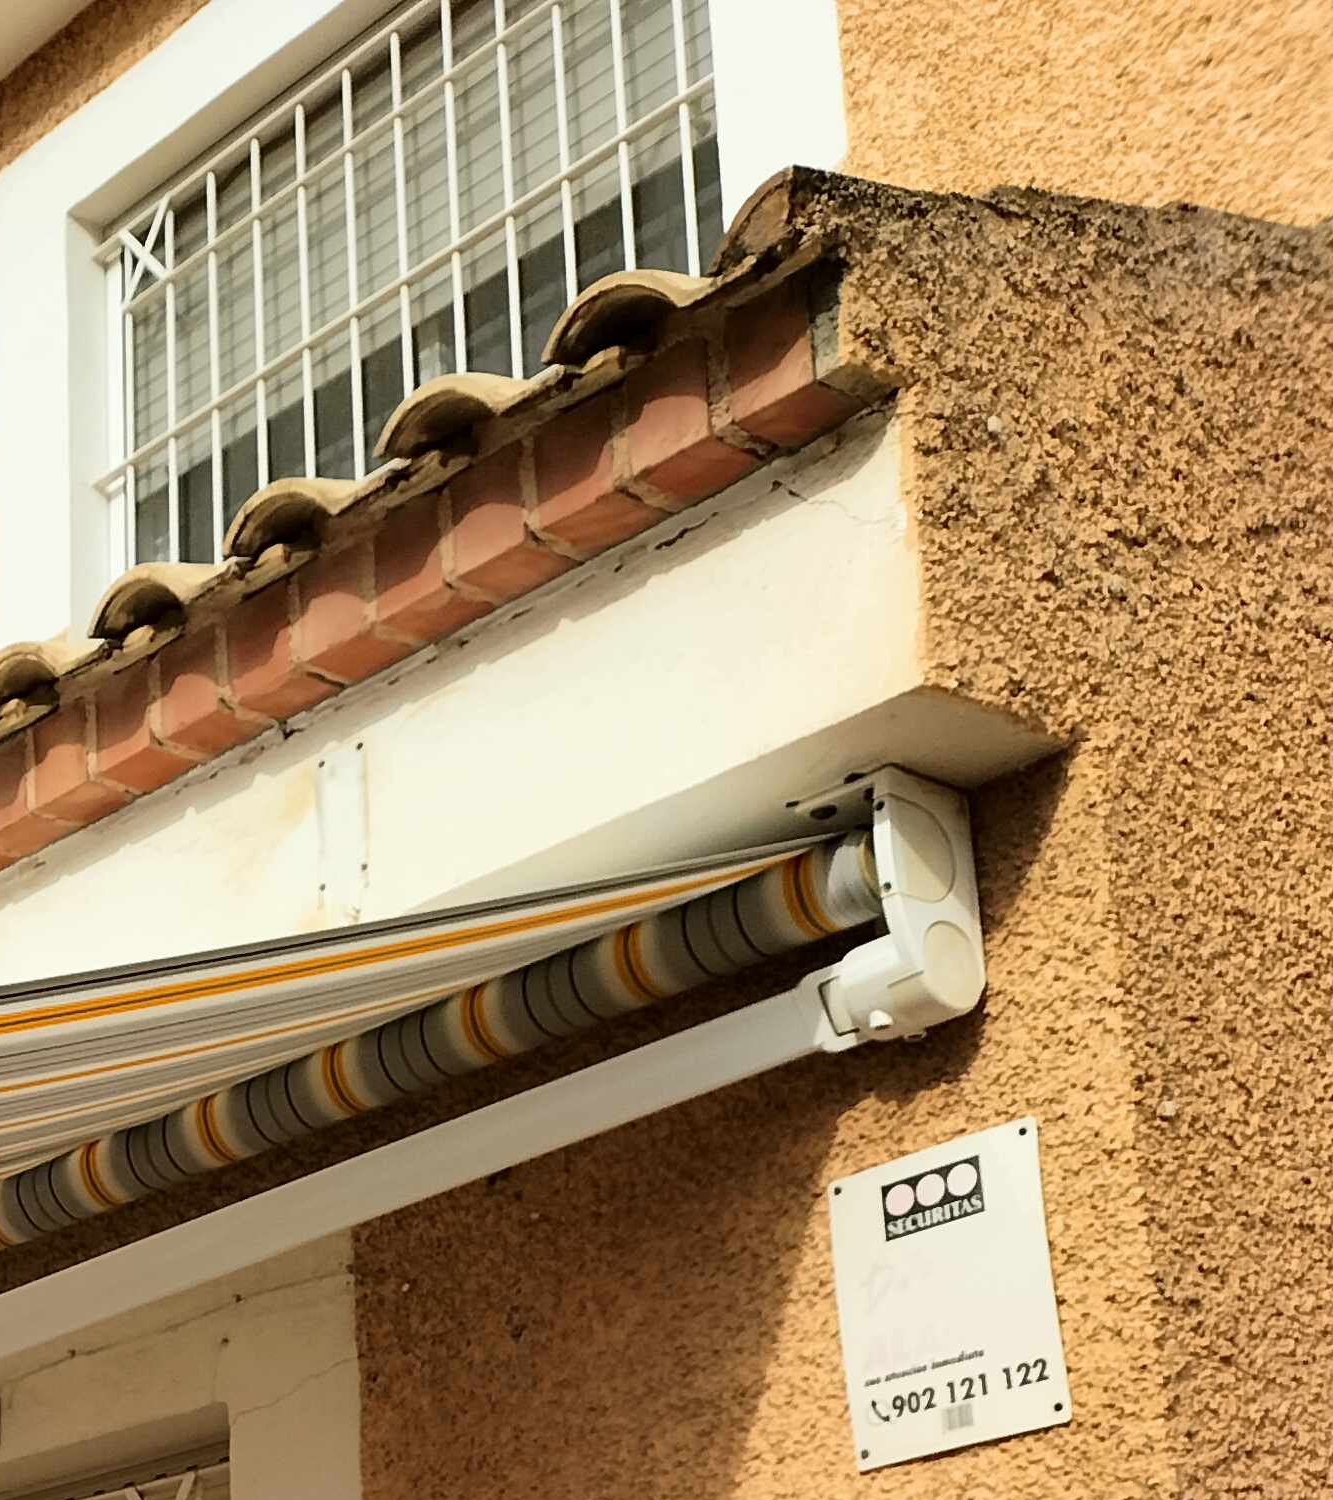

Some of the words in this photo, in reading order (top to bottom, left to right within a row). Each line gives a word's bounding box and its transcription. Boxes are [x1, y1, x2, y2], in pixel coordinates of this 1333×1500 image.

[887, 1194, 983, 1237] SECURITAS
[892, 1387, 937, 1418] 902
[946, 1373, 989, 1403] 121
[1002, 1358, 1049, 1390] 122
